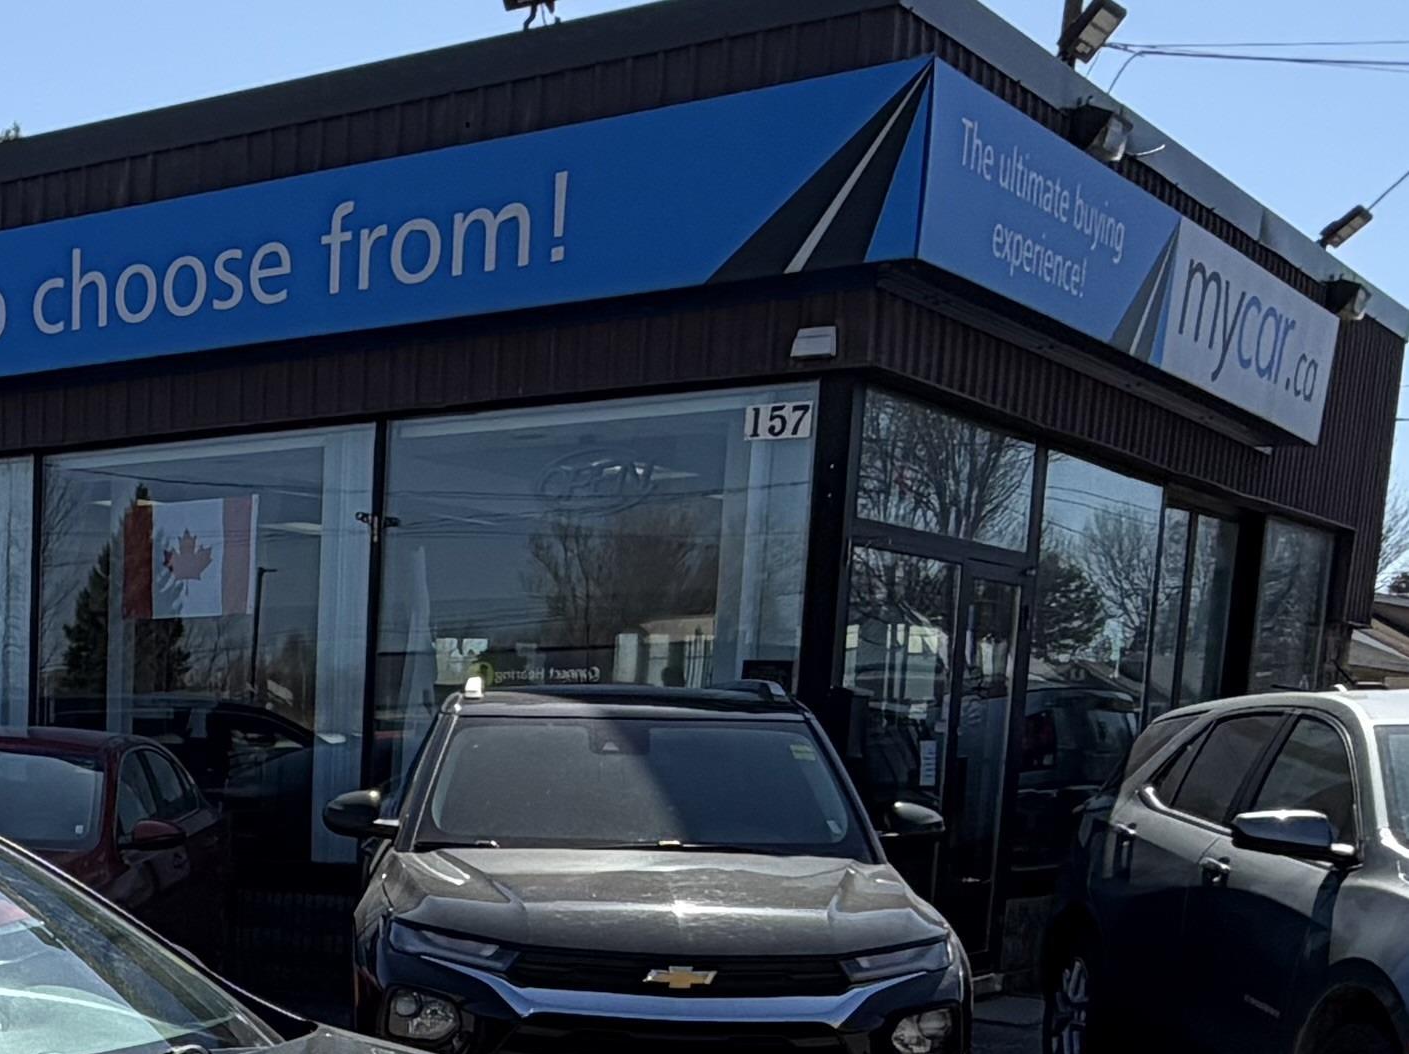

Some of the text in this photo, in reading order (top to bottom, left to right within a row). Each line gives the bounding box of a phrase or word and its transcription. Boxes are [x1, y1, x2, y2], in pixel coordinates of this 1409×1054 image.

[962, 117, 1125, 264] The ultimate buying
[32, 241, 292, 335] choose
[321, 171, 569, 295] from!
[992, 223, 1087, 298] experience!
[749, 404, 810, 438] 157
